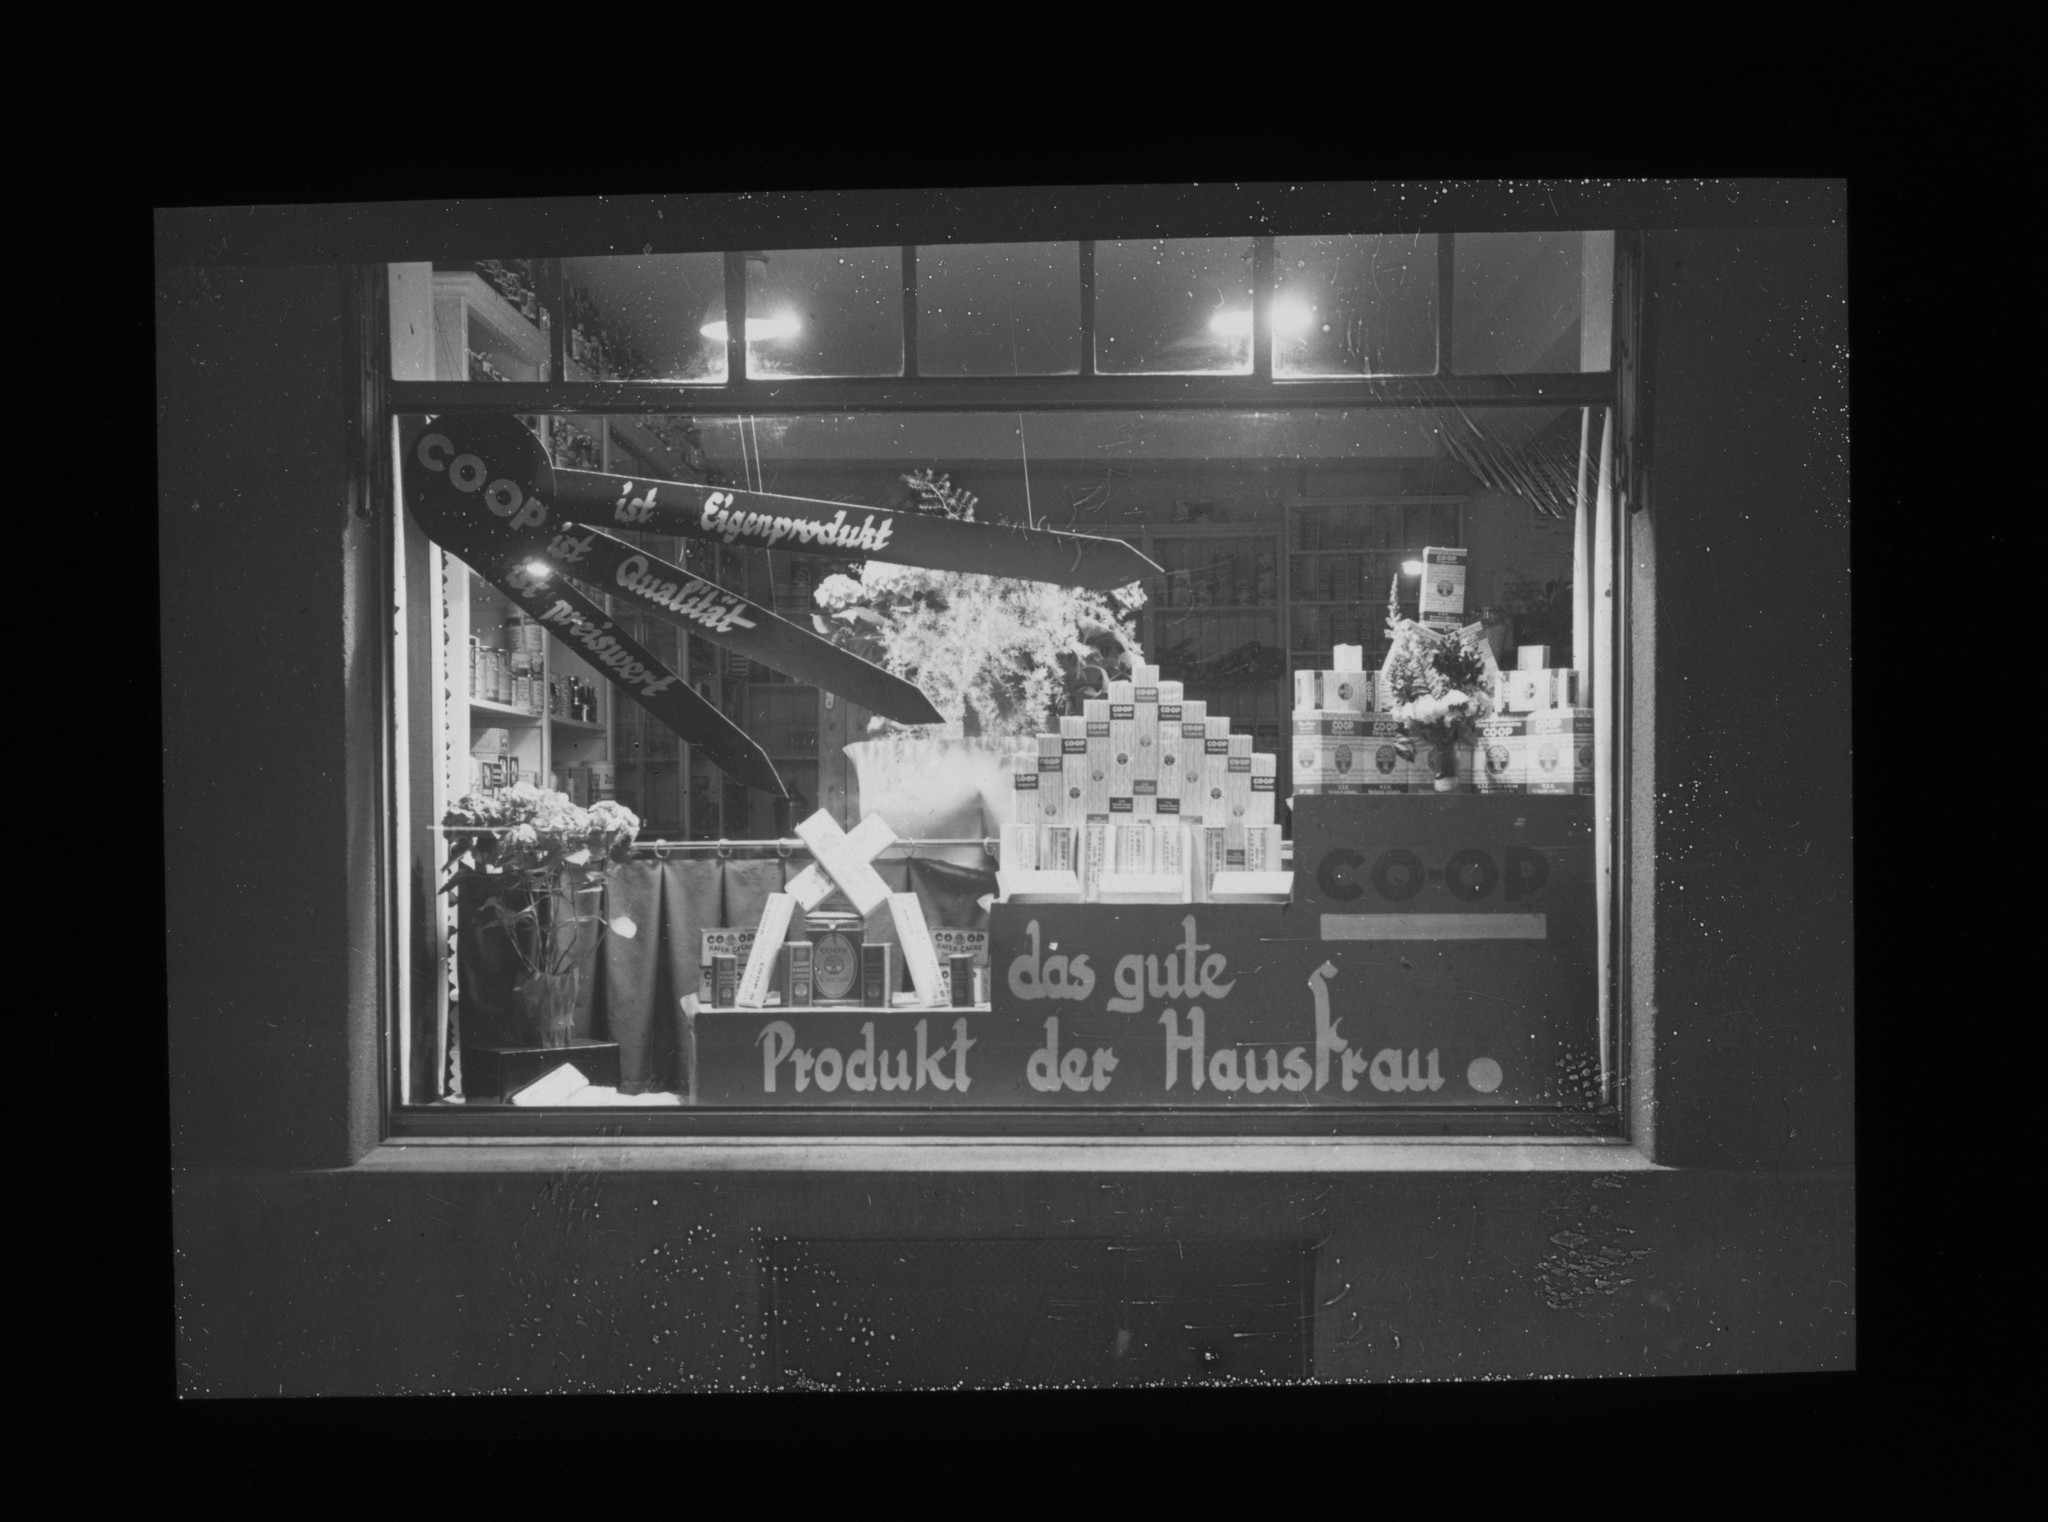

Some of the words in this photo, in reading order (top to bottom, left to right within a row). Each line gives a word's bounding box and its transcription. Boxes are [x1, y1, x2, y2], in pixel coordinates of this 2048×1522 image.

[614, 480, 657, 523] ist
[700, 491, 893, 552] Eigenprodukt
[546, 521, 596, 563] ist
[616, 554, 757, 632] Qualität
[538, 598, 678, 696] preiswert
[1007, 919, 1096, 1000] das
[1107, 914, 1237, 1013] gute
[755, 1017, 977, 1092] Produkt
[1026, 1016, 1119, 1092] der
